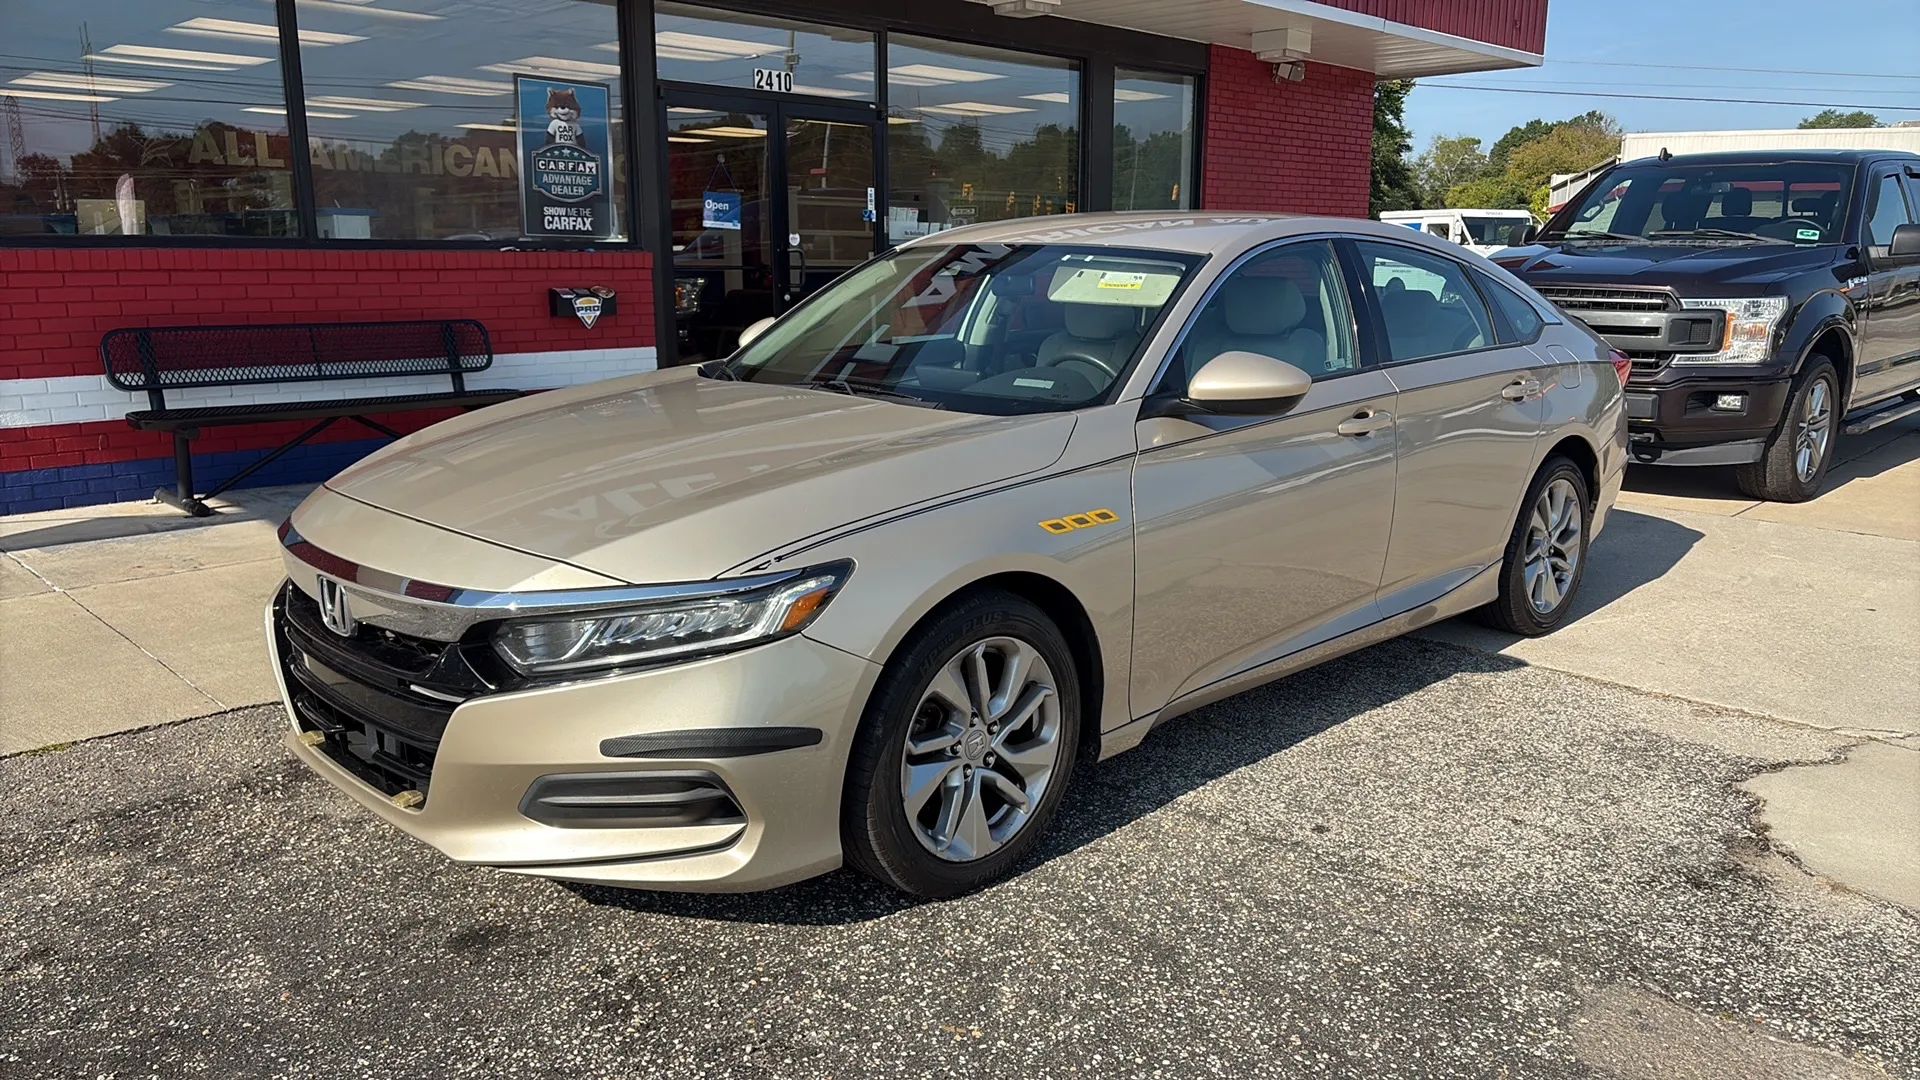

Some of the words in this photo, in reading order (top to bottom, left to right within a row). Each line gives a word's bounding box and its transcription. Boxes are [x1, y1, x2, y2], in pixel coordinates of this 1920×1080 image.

[755, 69, 793, 92] 2410
[557, 125, 573, 133] CAR
[559, 133, 574, 142] FOX
[188, 127, 286, 168] ALL
[538, 160, 597, 175] CARFAX
[542, 173, 593, 186] ADVANTAGE
[551, 184, 585, 196] DEALER
[704, 199, 729, 211] Open
[543, 206, 566, 216] SHOW
[567, 208, 578, 217] ME
[579, 208, 592, 218] THE
[544, 216, 593, 231] CARFAX
[577, 305, 600, 313] PRO
